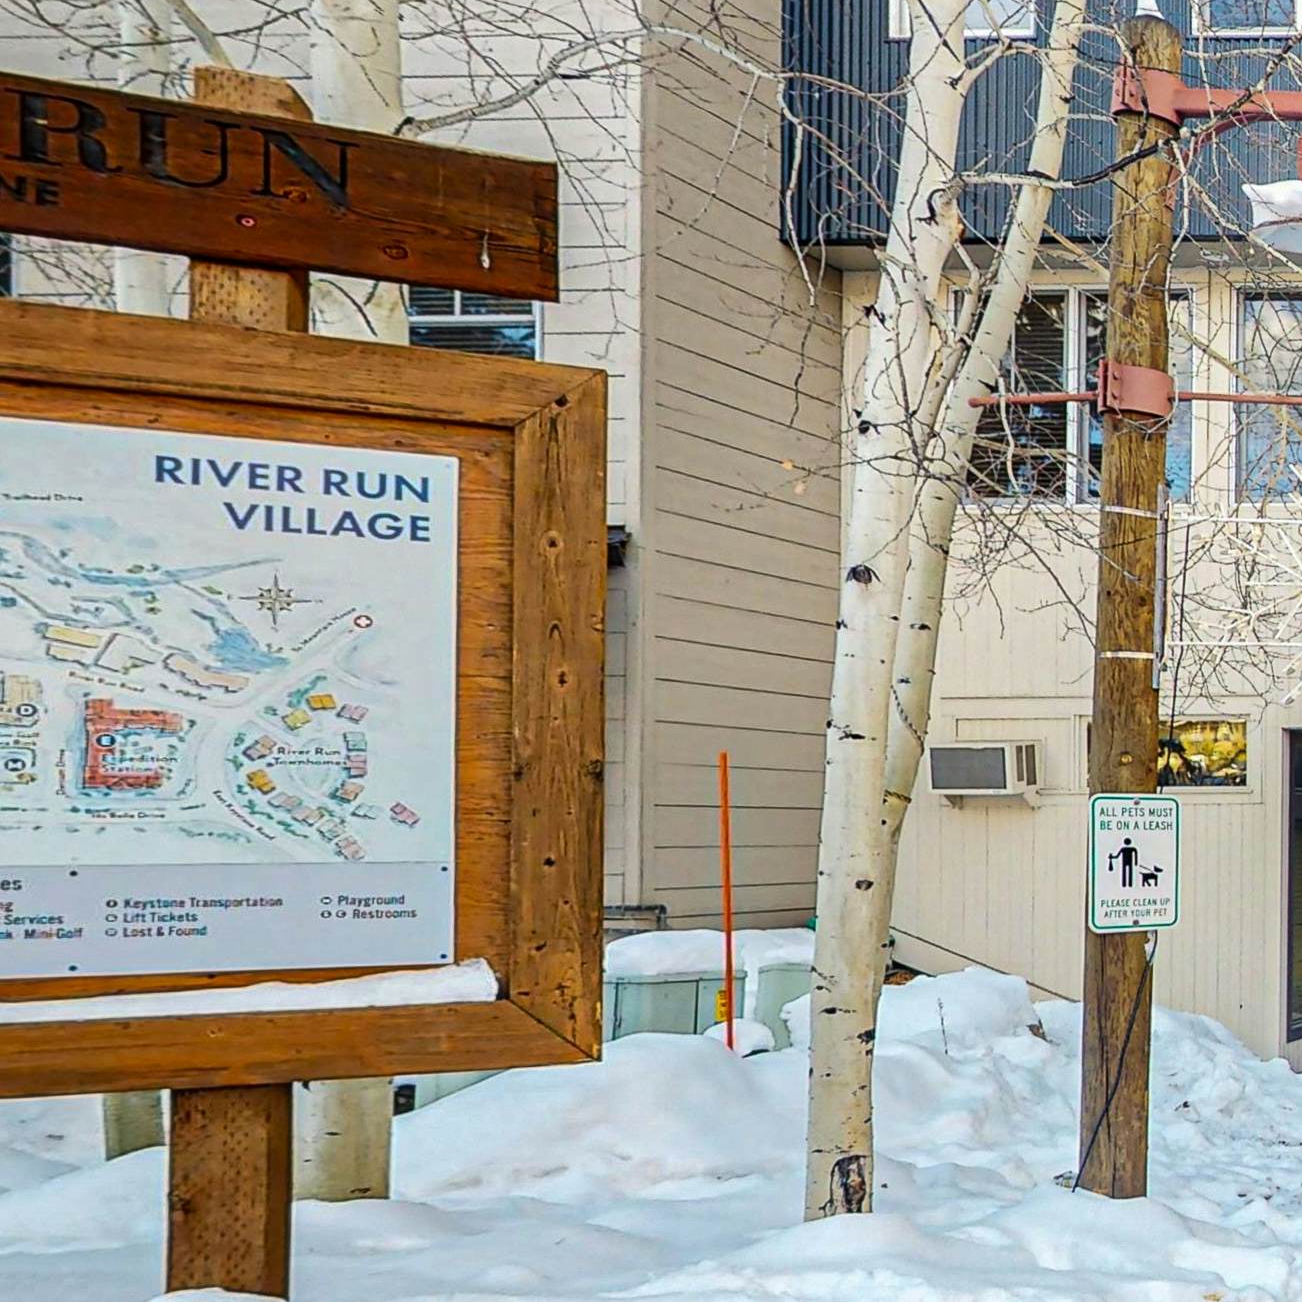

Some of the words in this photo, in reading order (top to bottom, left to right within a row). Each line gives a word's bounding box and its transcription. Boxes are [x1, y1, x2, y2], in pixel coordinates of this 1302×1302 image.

[4, 87, 361, 213] RUN
[154, 454, 306, 494] RIVER
[322, 468, 430, 503] RUN
[222, 501, 431, 543] VILLAGE
[277, 747, 311, 756] River
[314, 747, 341, 756] Run
[1099, 807, 1117, 817] ALL
[1121, 807, 1145, 817] PETS
[1148, 807, 1173, 817] MUST
[1099, 820, 1112, 830] BE
[1116, 820, 1130, 830] ON
[1133, 821, 1140, 830] A
[1143, 820, 1173, 830] LEASH
[124, 898, 185, 910] Keystone
[188, 897, 283, 910] Transportation
[337, 895, 405, 908] Playground
[1100, 899, 1130, 908] PLEASE
[1133, 899, 1157, 907] CLEAN
[1160, 898, 1170, 906] UP
[123, 913, 146, 923] Lift
[150, 912, 199, 923] Tickets
[352, 909, 417, 919] Restrooms
[1104, 909, 1128, 918] AFTER
[1131, 909, 1151, 917] YOUR
[1153, 908, 1167, 916] PET
[4, 914, 64, 926] Services
[123, 928, 151, 938] Lost
[156, 927, 165, 937] &
[168, 926, 207, 937] Found
